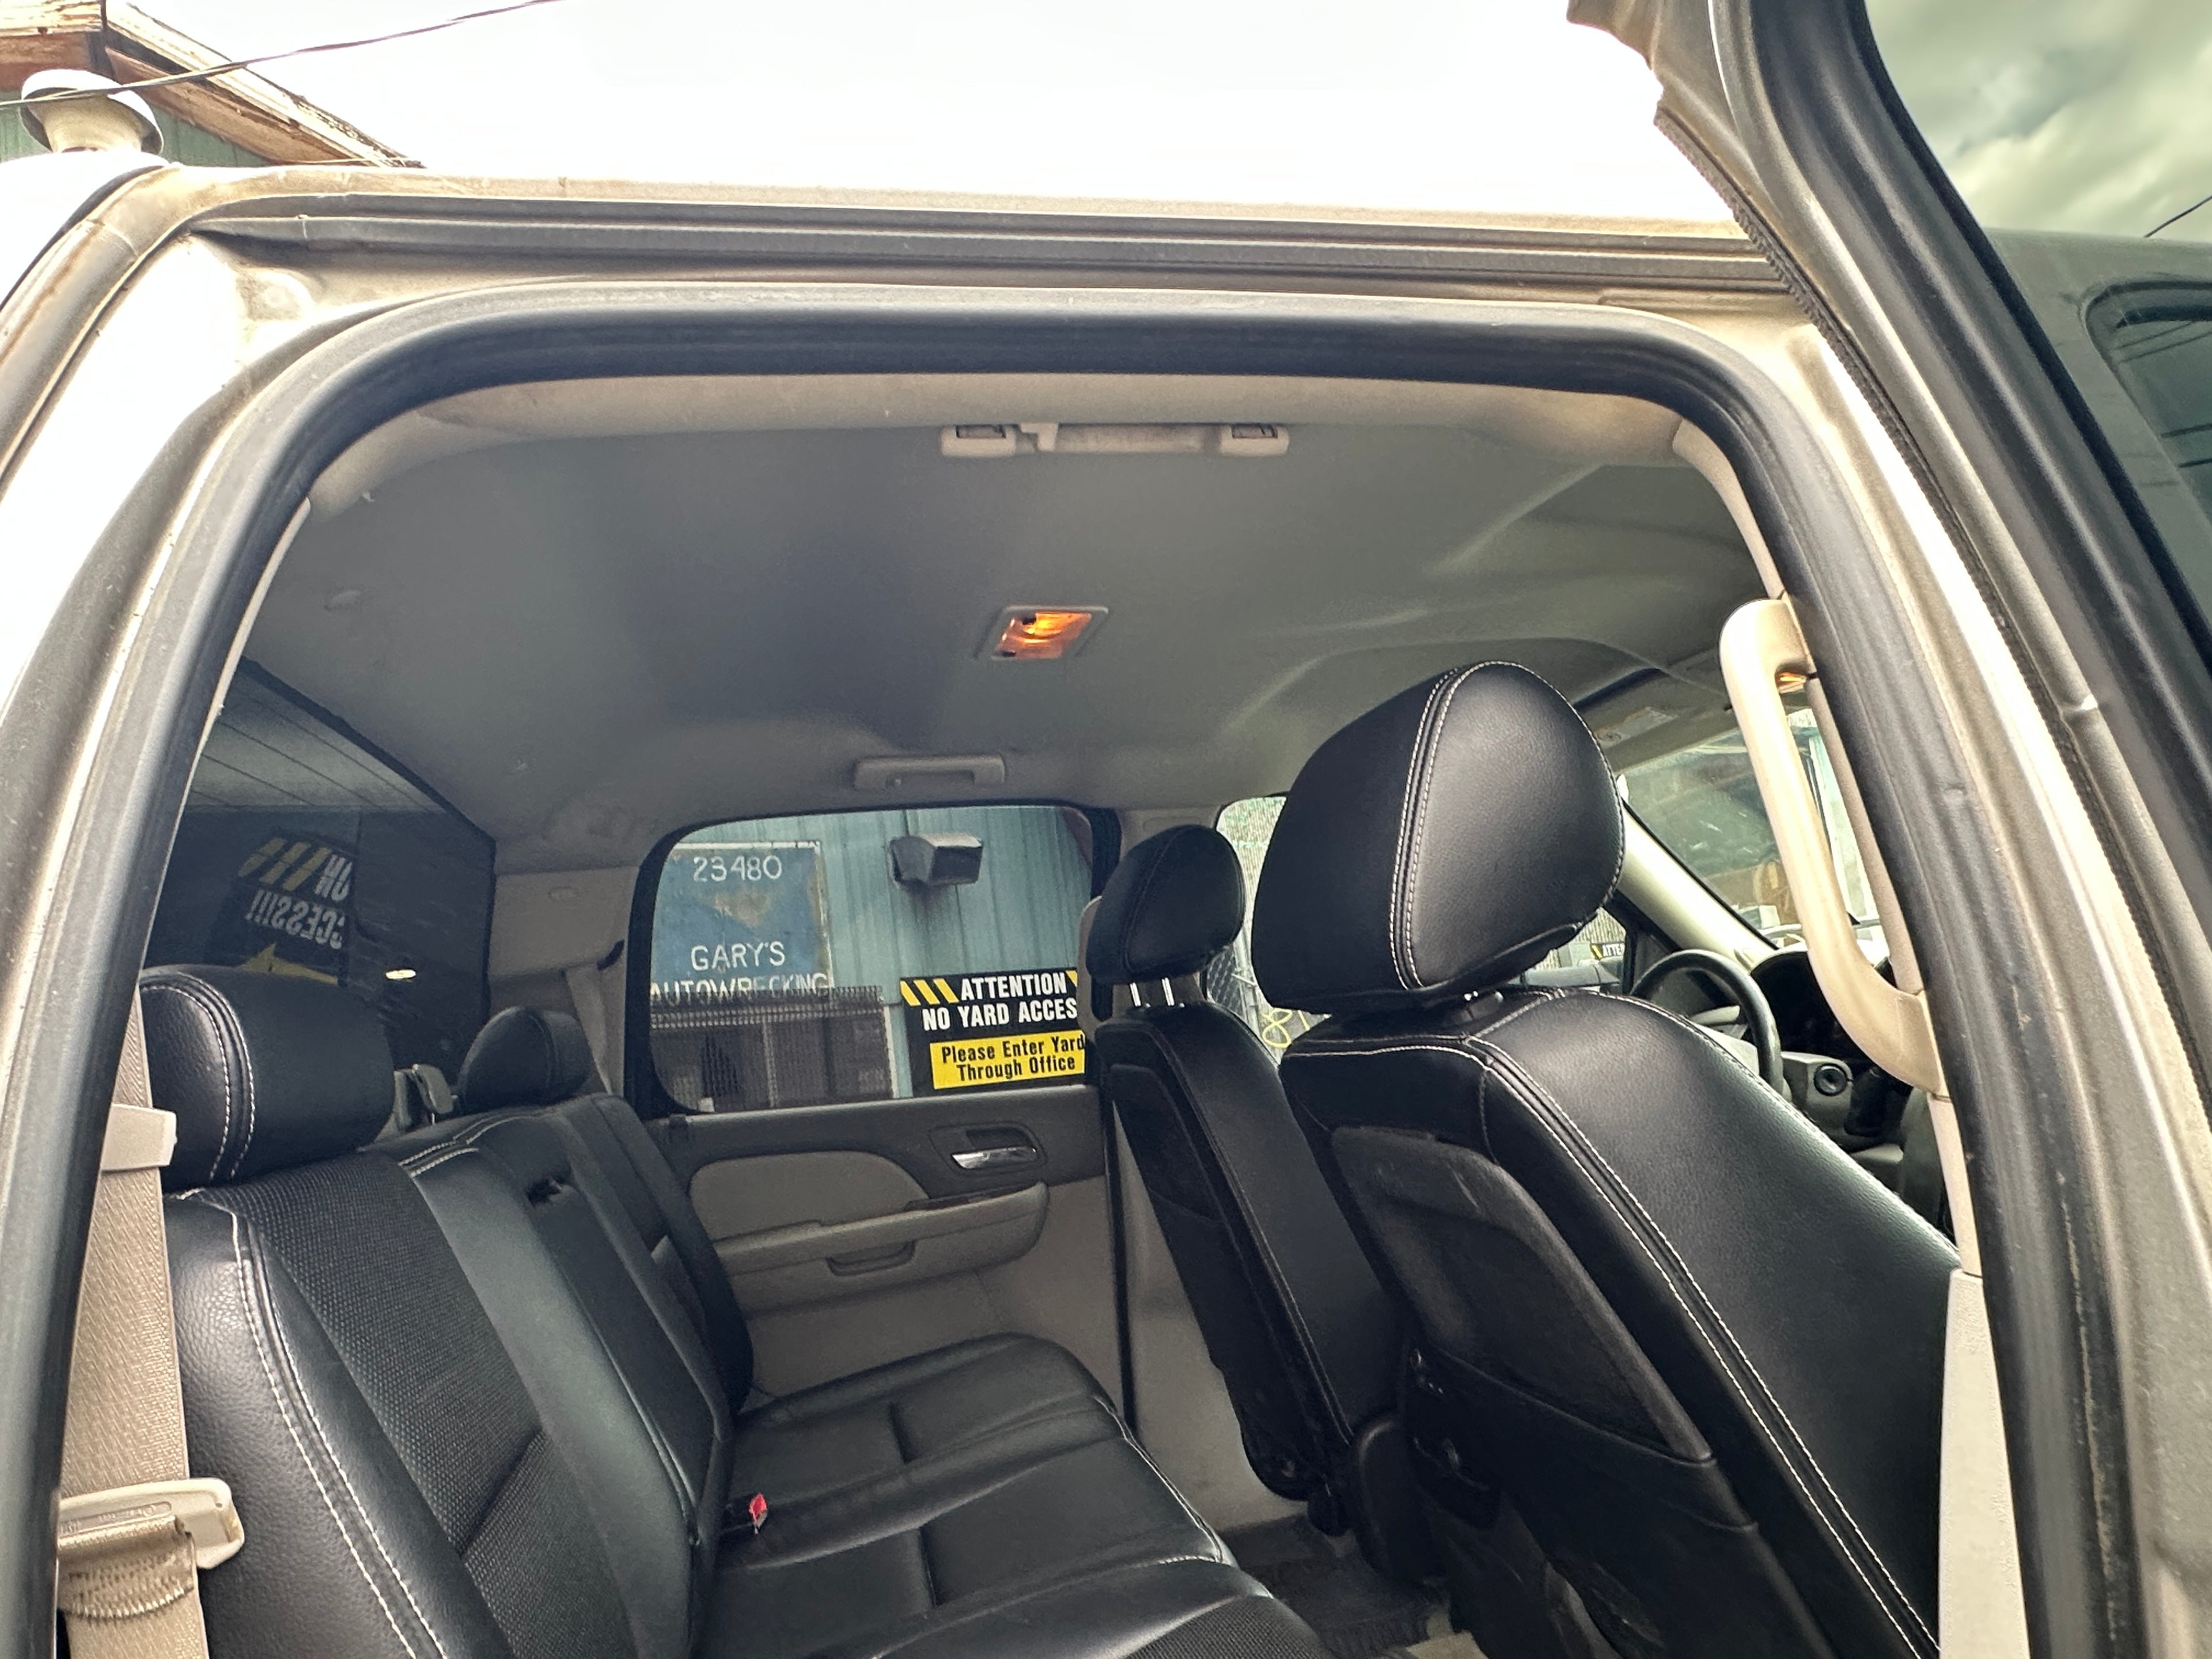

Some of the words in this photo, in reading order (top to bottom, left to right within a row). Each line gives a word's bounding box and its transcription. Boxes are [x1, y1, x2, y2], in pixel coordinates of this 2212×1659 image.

[693, 855, 782, 882] 23480
[691, 941, 785, 971] GARY'S
[961, 972, 1067, 1001] ATTENTION
[922, 1007, 950, 1031] NO
[958, 1003, 1009, 1028] YARD
[1018, 998, 1078, 1024] ACCES
[941, 1046, 995, 1063] Please
[1002, 1040, 1045, 1058] Enter
[956, 1059, 1022, 1081] Through
[1029, 1056, 1075, 1073] Office
